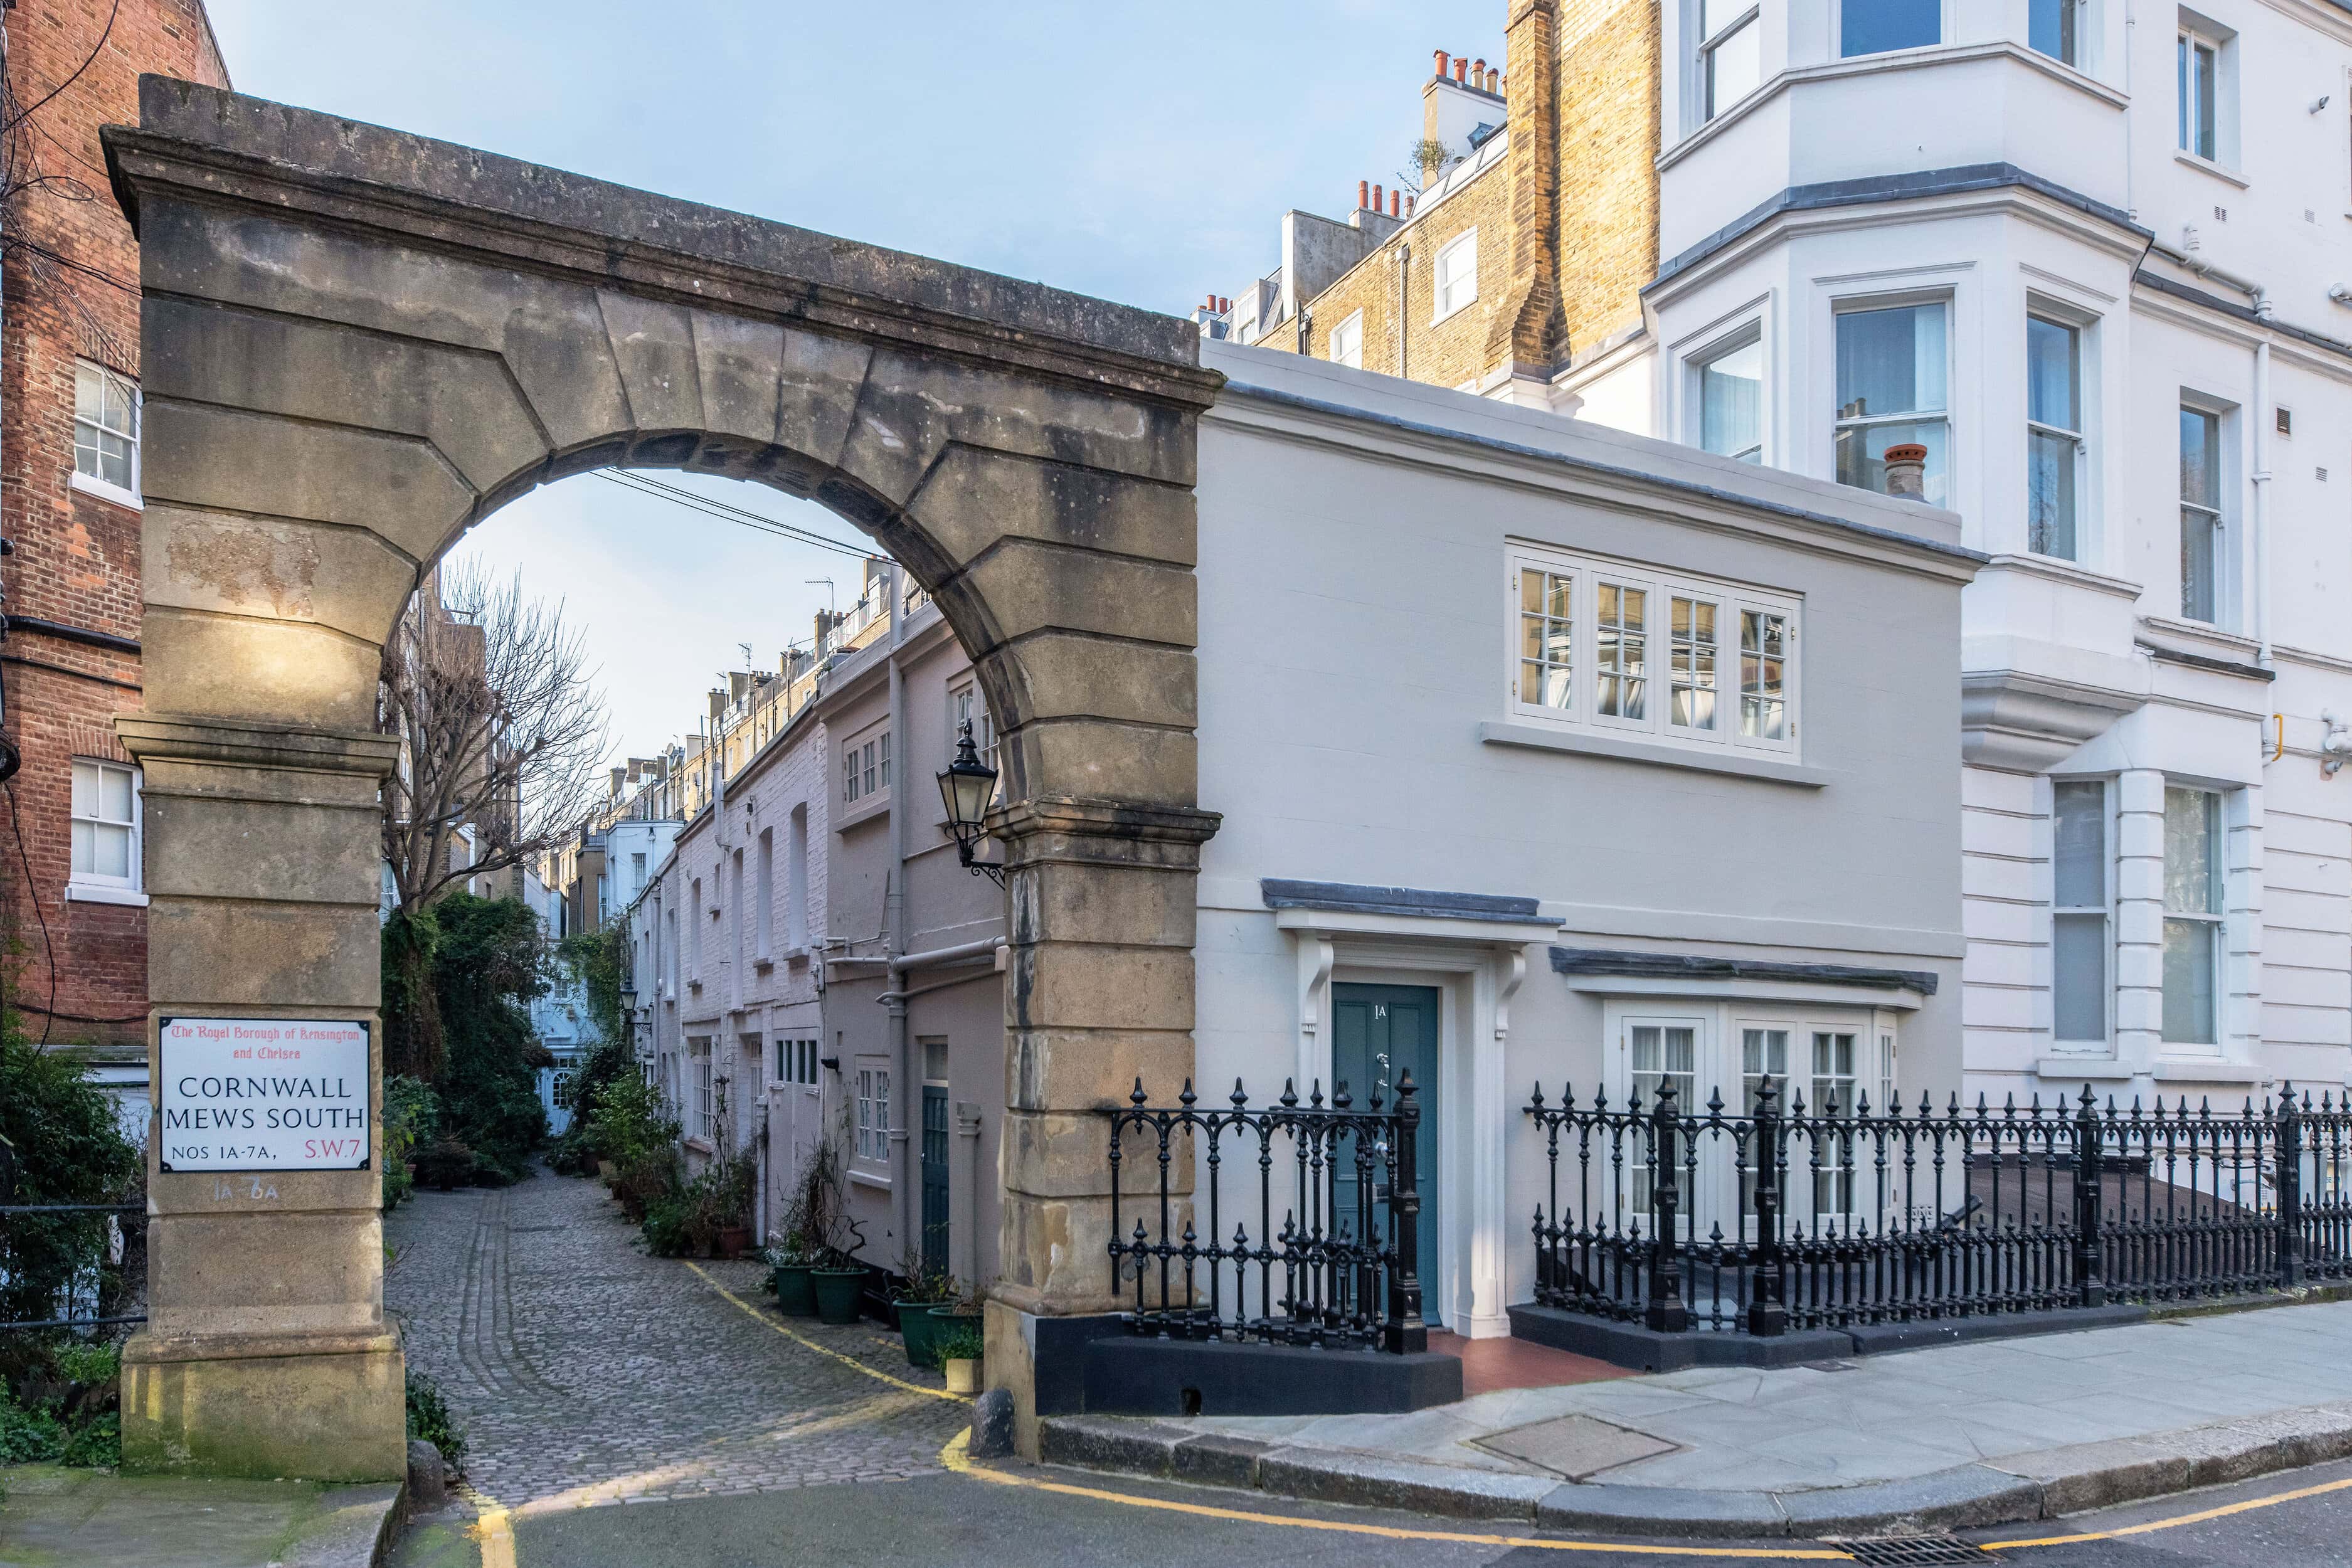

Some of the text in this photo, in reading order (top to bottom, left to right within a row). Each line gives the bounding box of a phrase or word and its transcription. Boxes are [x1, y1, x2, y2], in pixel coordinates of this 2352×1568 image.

[1375, 1005, 1386, 1019] 1A
[171, 1025, 359, 1044] The Royal Borough of Kensington
[234, 1047, 300, 1059] and Chelsea
[179, 1078, 351, 1098] CORNWALL
[166, 1108, 364, 1129] MEWS SOUTH
[172, 1147, 208, 1159] NOS
[305, 1140, 360, 1158] S.W.7
